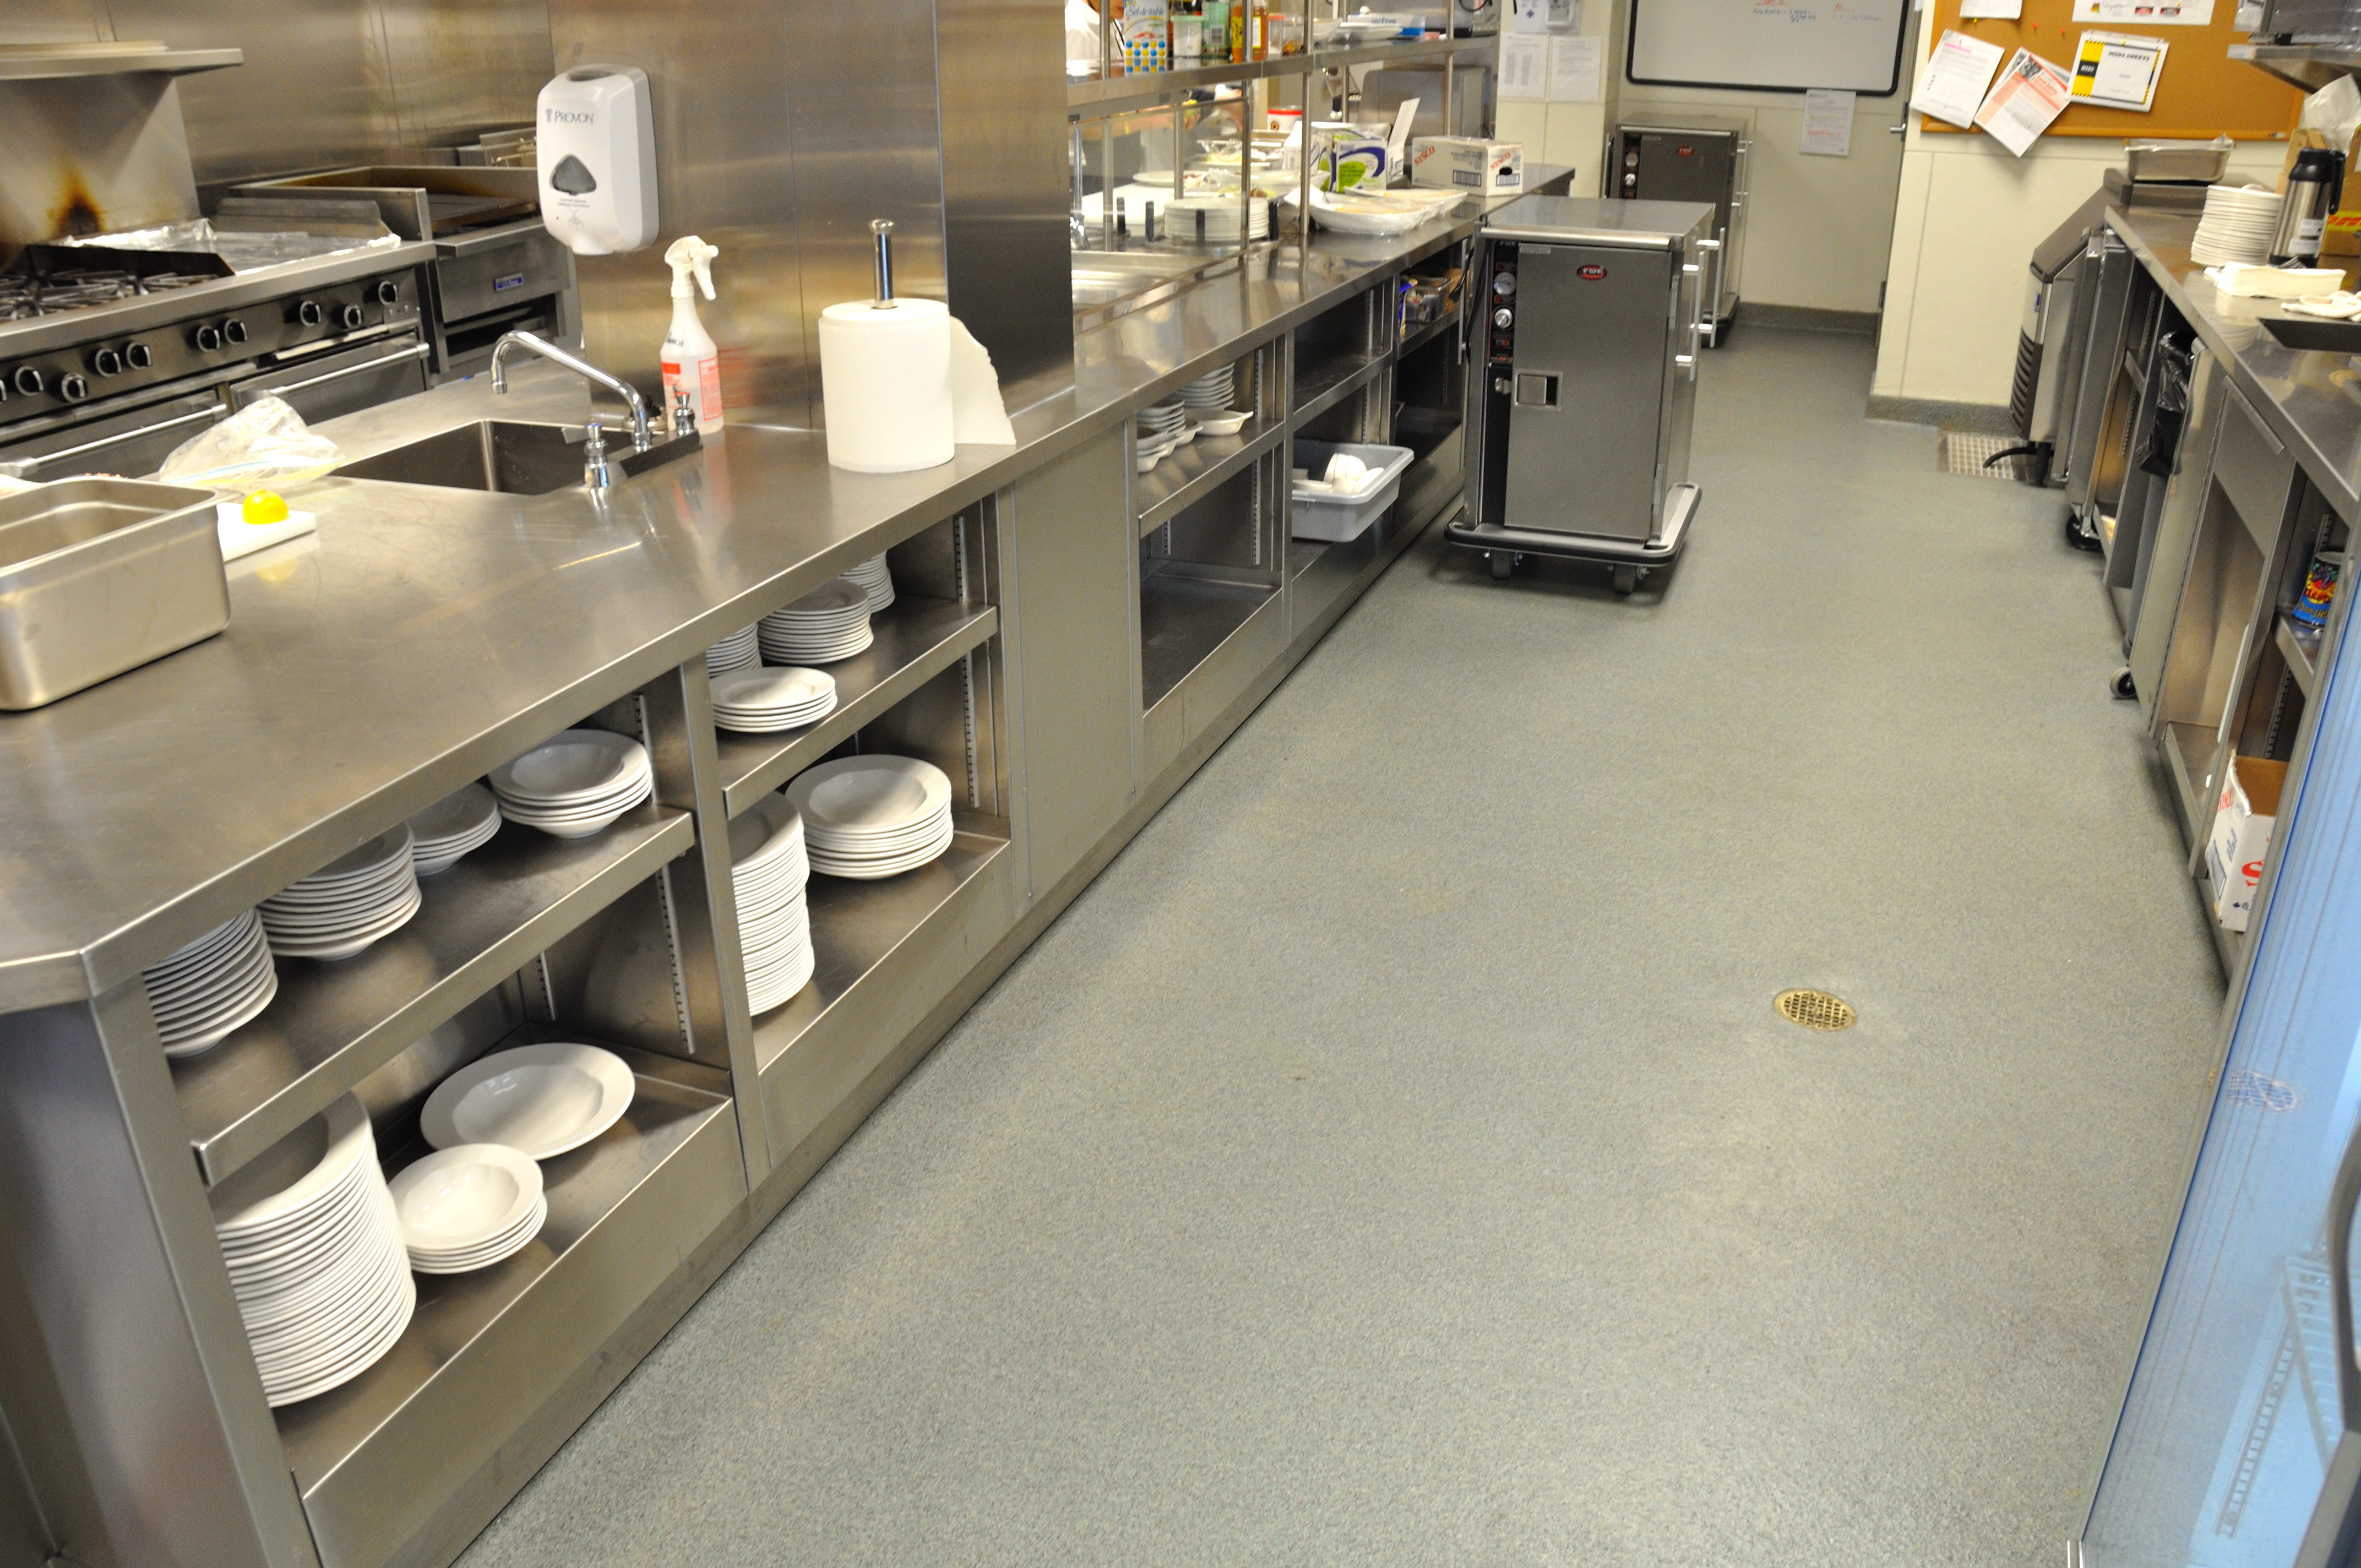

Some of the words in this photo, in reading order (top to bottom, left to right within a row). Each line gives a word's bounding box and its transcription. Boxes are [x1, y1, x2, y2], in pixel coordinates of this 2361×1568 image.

[1148, 6, 1166, 15] table
[555, 111, 594, 124] PROVON
[1415, 146, 1435, 166] SYSCO
[1490, 152, 1510, 170] SYSCO
